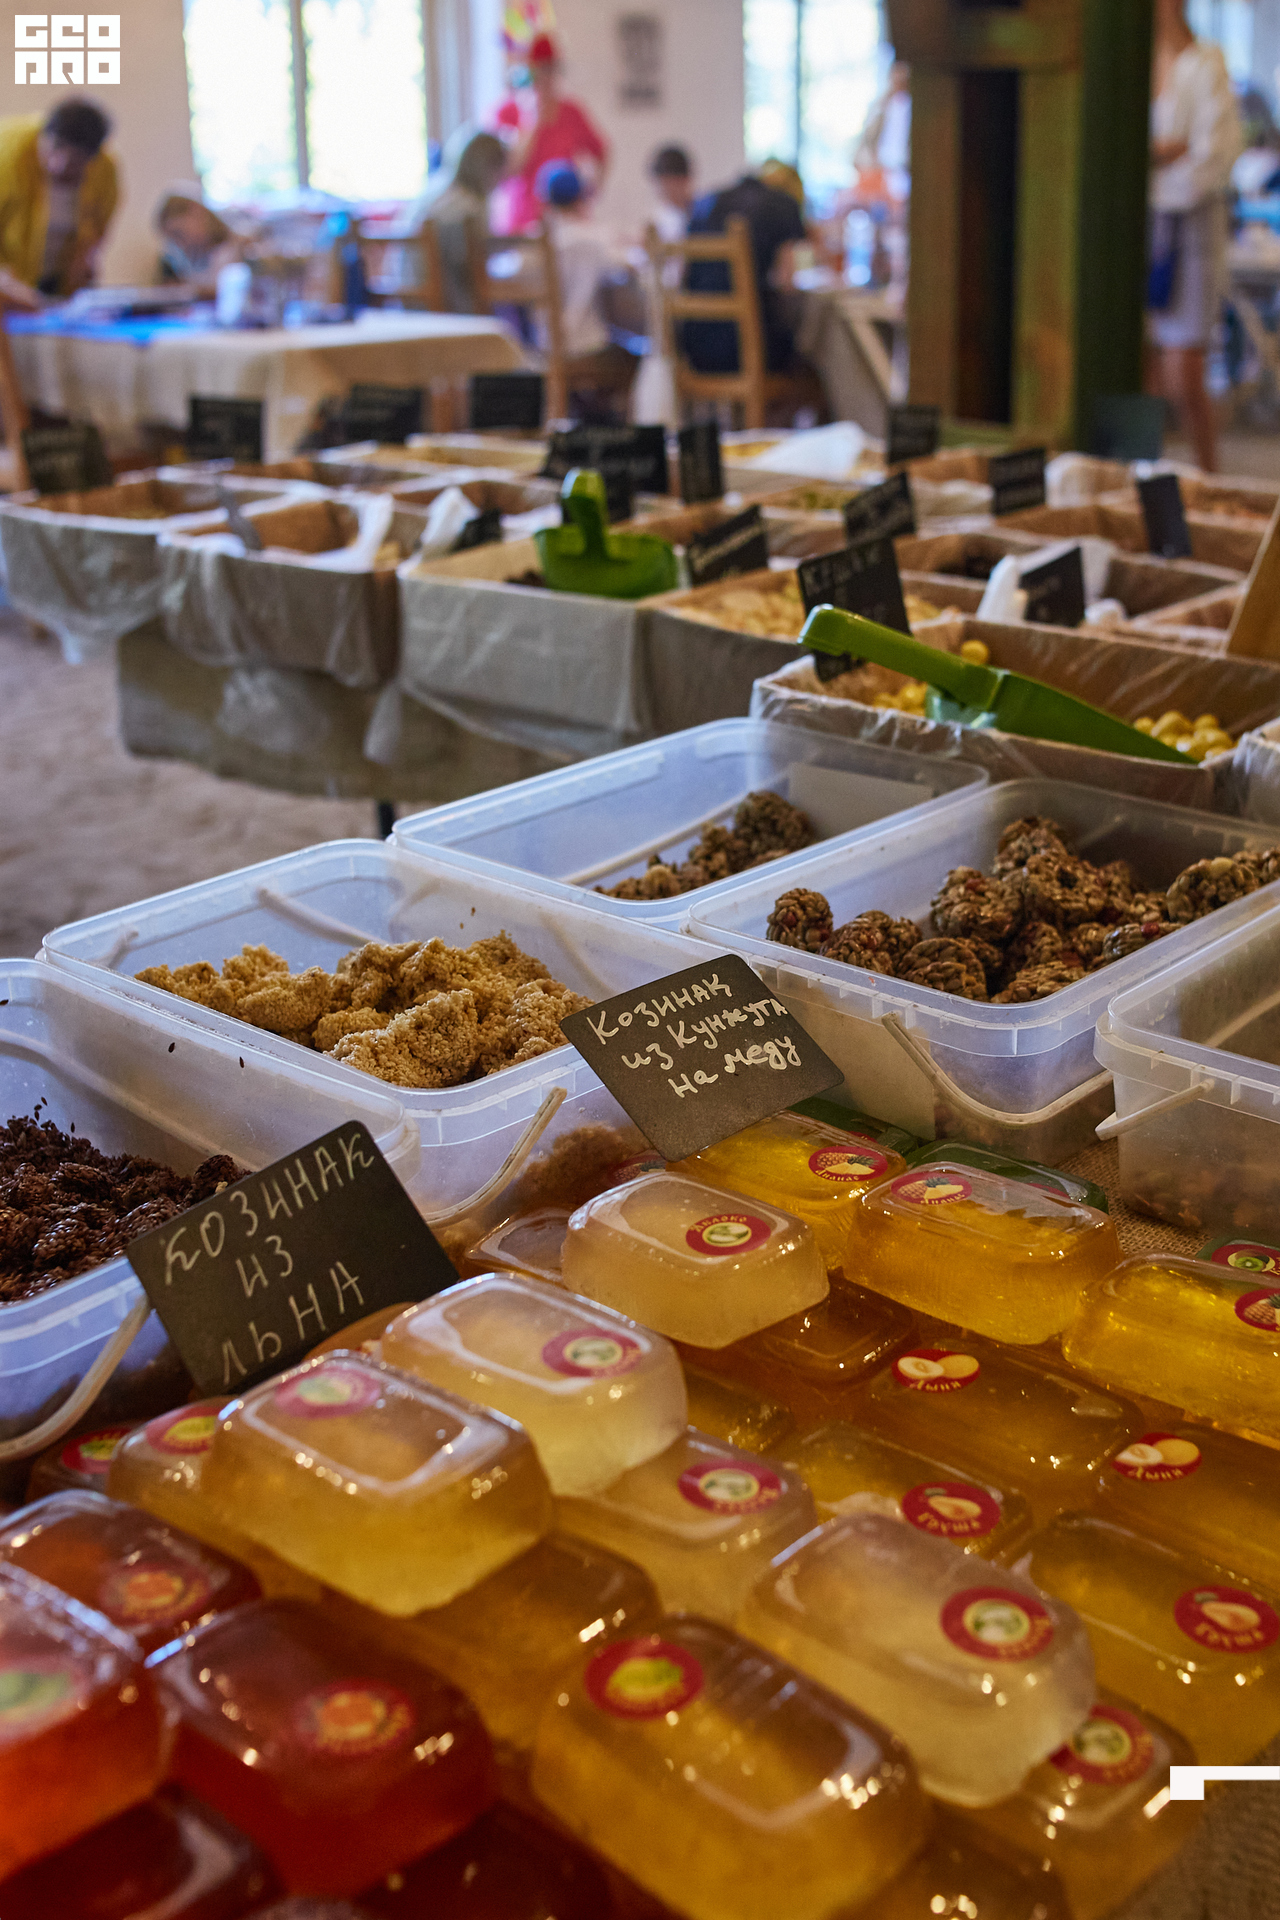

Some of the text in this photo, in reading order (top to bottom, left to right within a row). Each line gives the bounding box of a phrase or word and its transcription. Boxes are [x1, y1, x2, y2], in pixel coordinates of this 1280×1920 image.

[621, 1042, 674, 1070] из
[723, 1035, 802, 1073] меду
[236, 1235, 293, 1298] ИЗ
[221, 1261, 364, 1385] ЛЬНА
